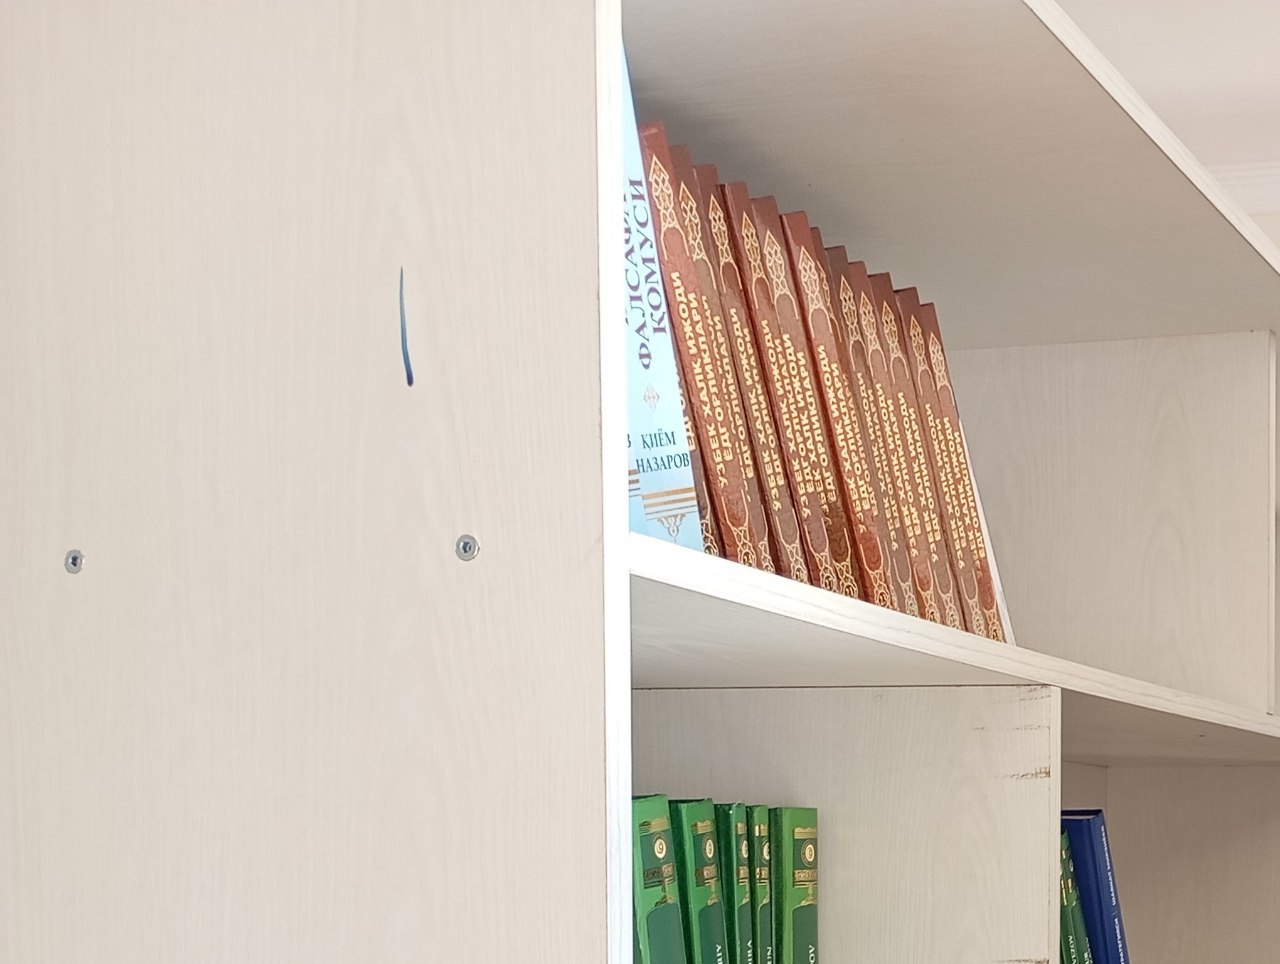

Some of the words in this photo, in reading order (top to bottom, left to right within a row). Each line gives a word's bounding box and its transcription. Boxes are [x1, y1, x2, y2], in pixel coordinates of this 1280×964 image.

[670, 270, 698, 354] ИЖОДИ
[728, 307, 753, 385] ИЖОДИ
[687, 291, 735, 461] ЁДГОРЛИКЛАРИ
[760, 319, 785, 395] ИЖОДИ
[781, 332, 805, 407] ИЖОДИ
[816, 344, 840, 417] ИЖОДИ
[856, 372, 875, 439] ИЖОДИ
[874, 382, 895, 449] ИЖОДИ
[897, 391, 916, 457] ИЖОДИ
[924, 403, 943, 467] ИЖОДИ
[636, 452, 690, 474] НАЗАРОВ
[942, 416, 961, 478] ИЖОДИ
